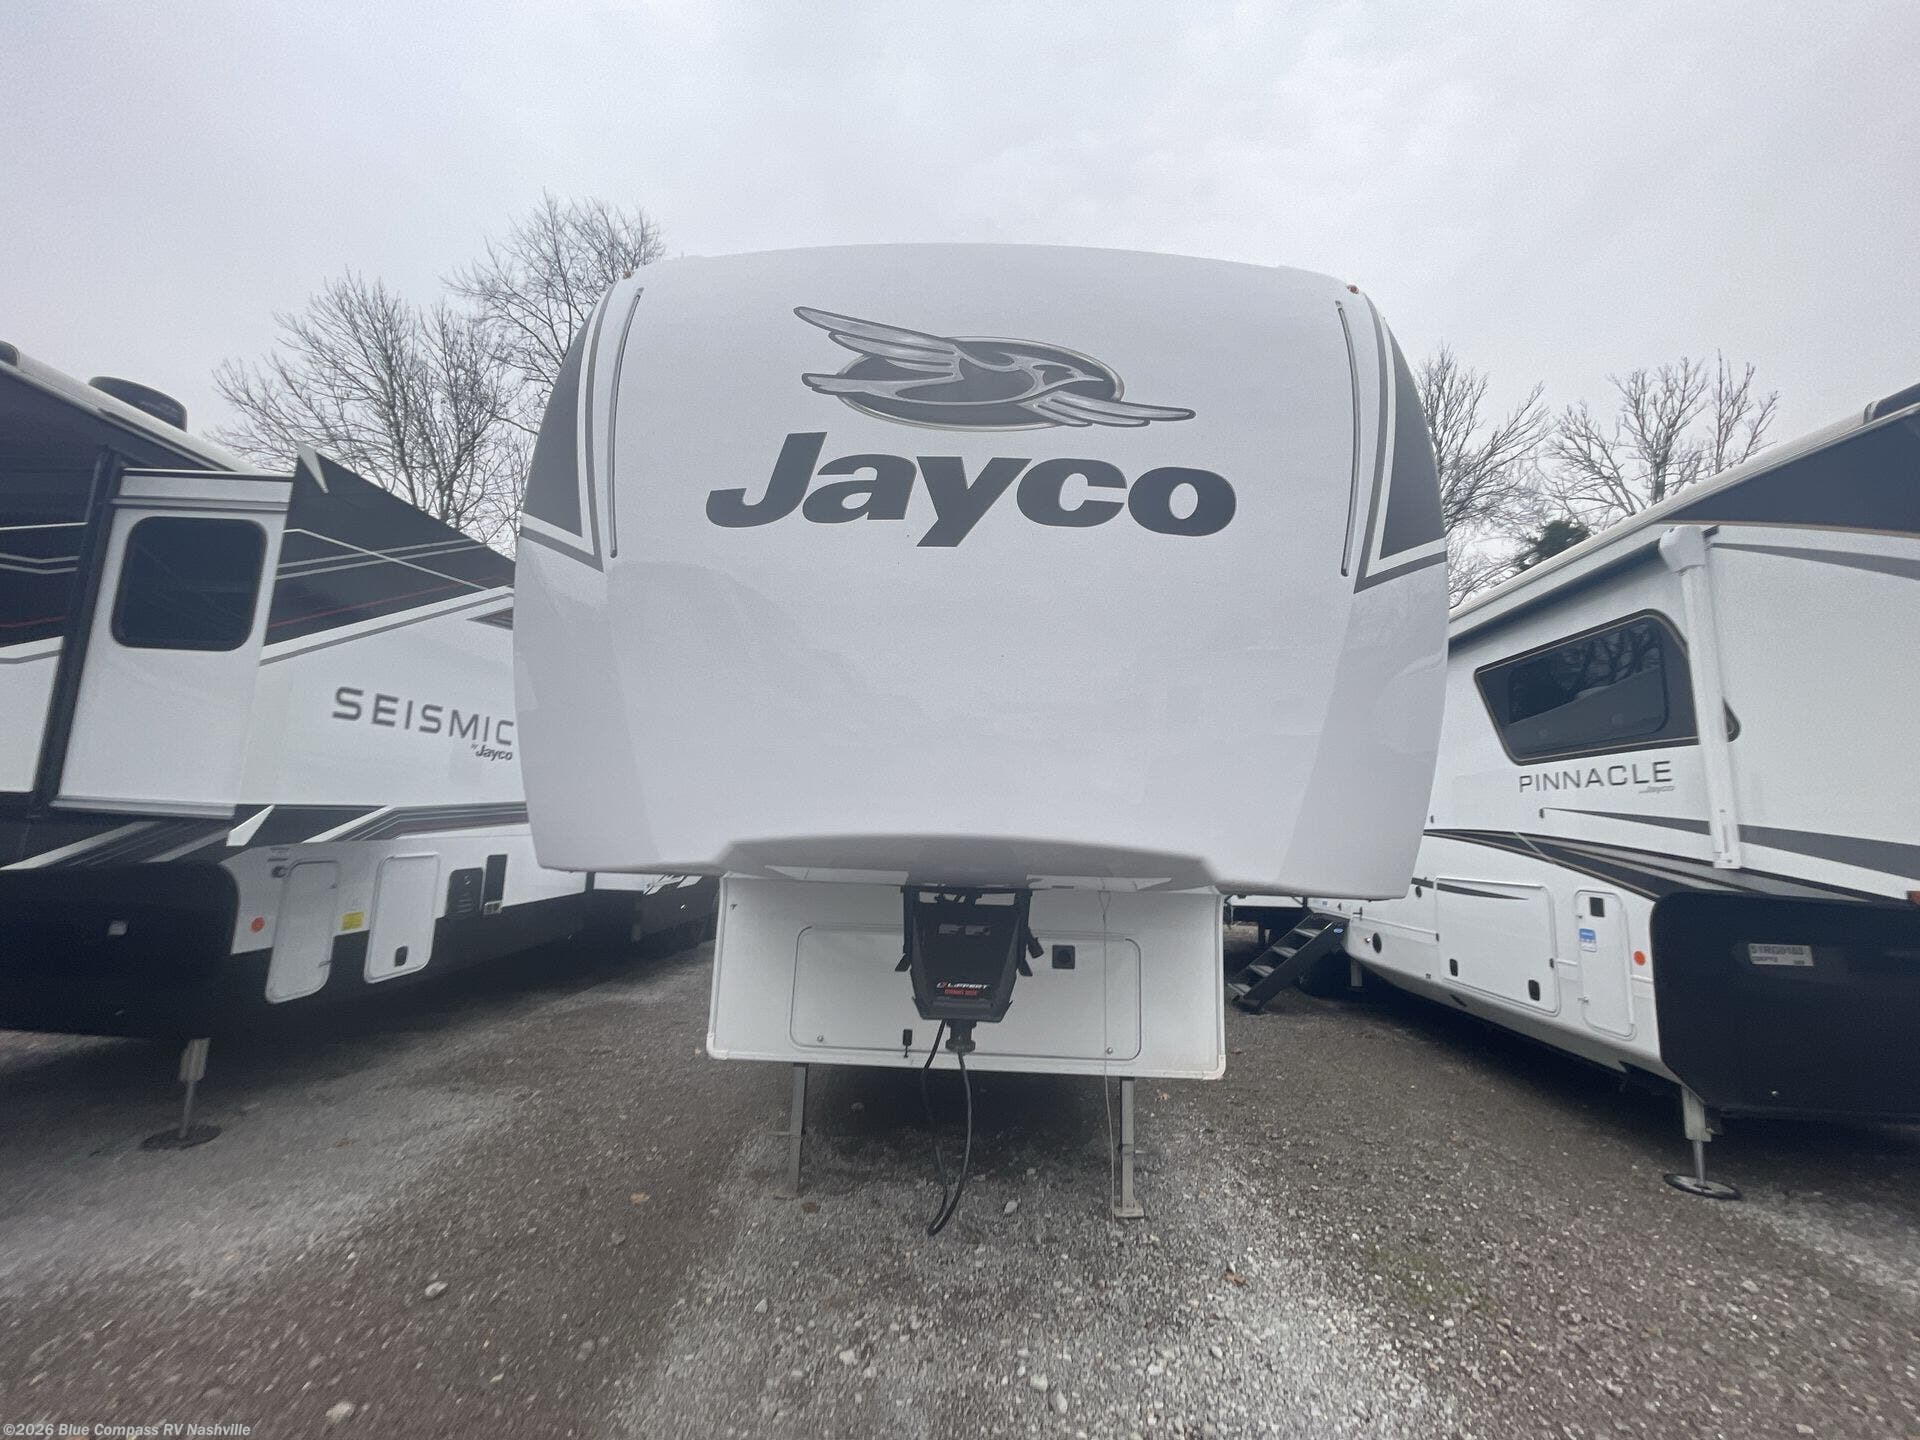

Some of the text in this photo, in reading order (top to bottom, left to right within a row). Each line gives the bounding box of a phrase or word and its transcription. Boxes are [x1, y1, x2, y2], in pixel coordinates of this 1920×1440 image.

[705, 431, 1237, 547] Jayco
[332, 686, 514, 746] SEISMIC
[475, 744, 513, 761] Jayco
[1519, 760, 1672, 793] PINNACLE
